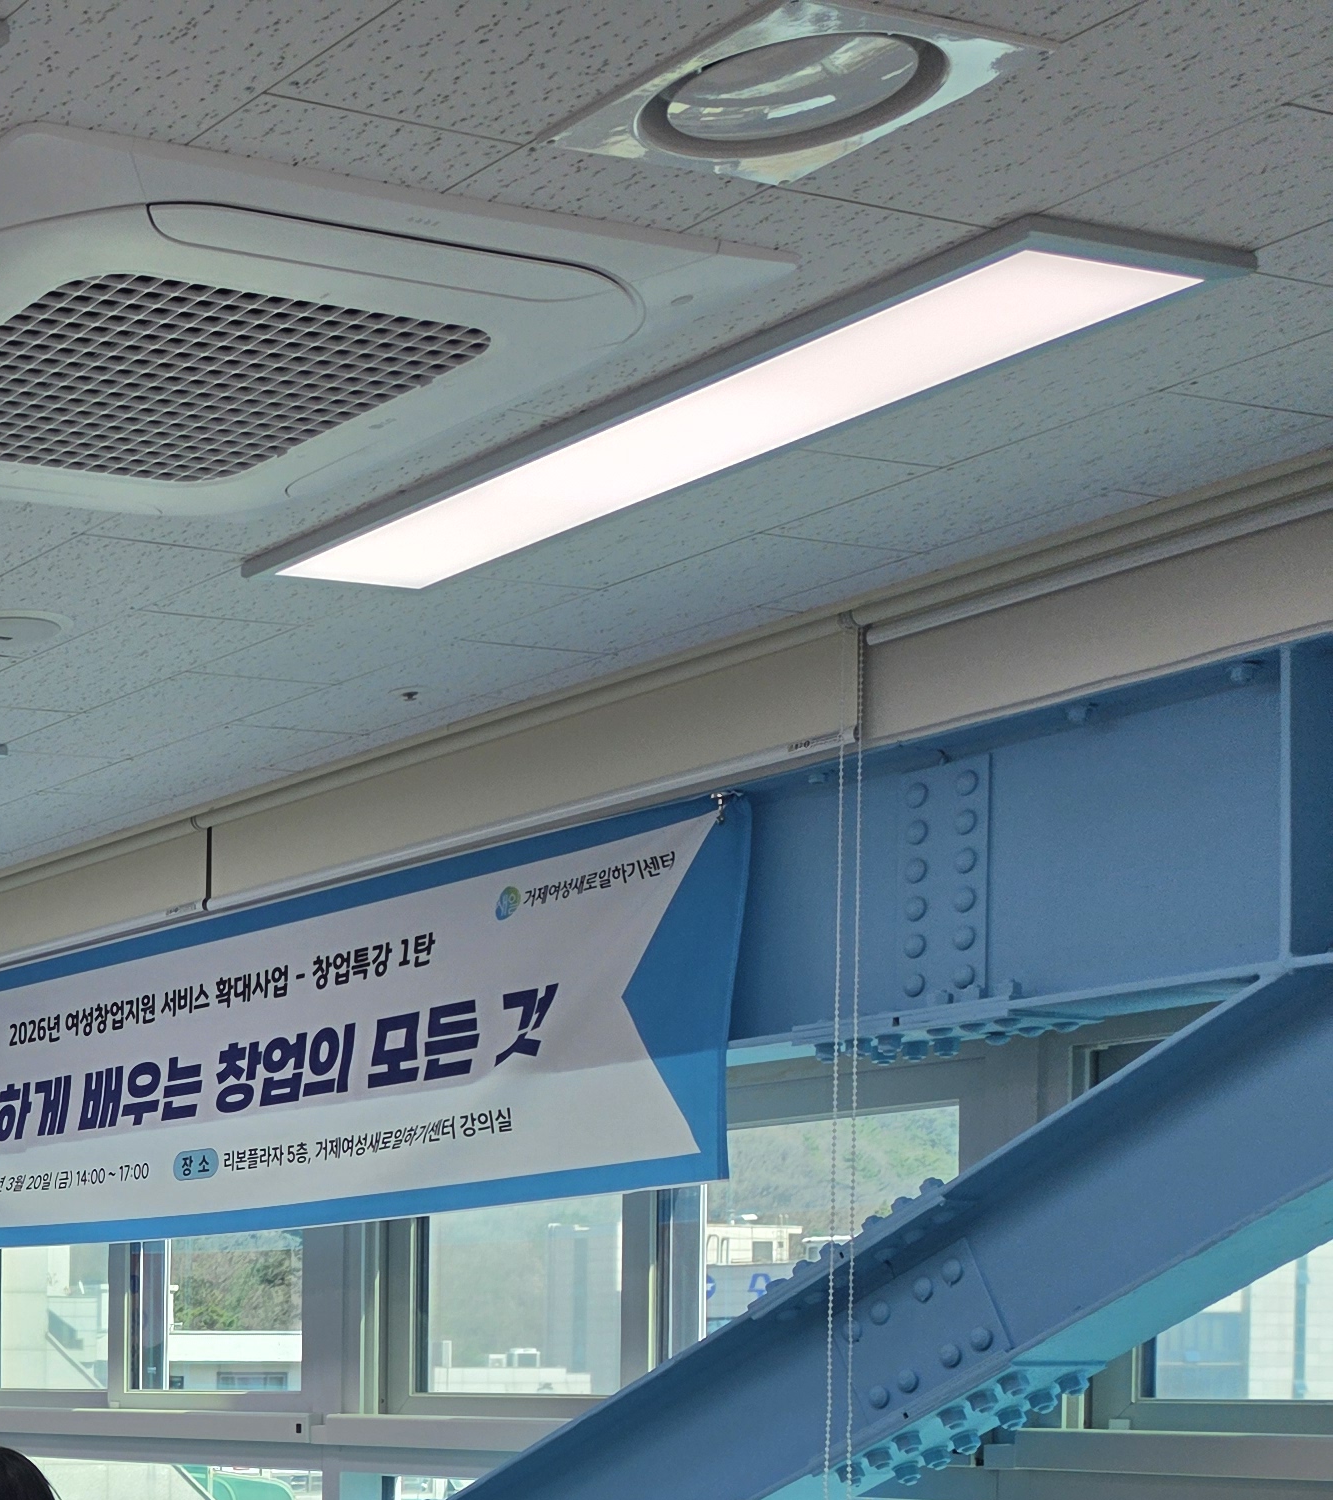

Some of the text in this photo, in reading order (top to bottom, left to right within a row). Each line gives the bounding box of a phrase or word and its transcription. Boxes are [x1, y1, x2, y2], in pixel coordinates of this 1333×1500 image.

[523, 850, 676, 908] 거제여성새로일하기센터
[8, 1013, 61, 1047] 2026년
[65, 993, 156, 1037] 여성창업지원
[160, 985, 210, 1017] 서비스
[215, 964, 289, 1009] 확대사업
[312, 938, 392, 990] 창업특강
[398, 932, 436, 968] 1탄
[78, 1056, 203, 1132] 배우는
[215, 1022, 357, 1114] 창업의
[367, 999, 481, 1089] 모든
[493, 982, 560, 1068] 것
[222, 1106, 514, 1172] 리본플라자 5층, 거제여성새로일하기센터 강의실
[5, 1173, 27, 1192] 3월
[25, 1171, 53, 1191] 20일
[53, 1170, 74, 1190] (금)
[75, 1167, 107, 1187] 14:00
[118, 1162, 150, 1182] 17:00
